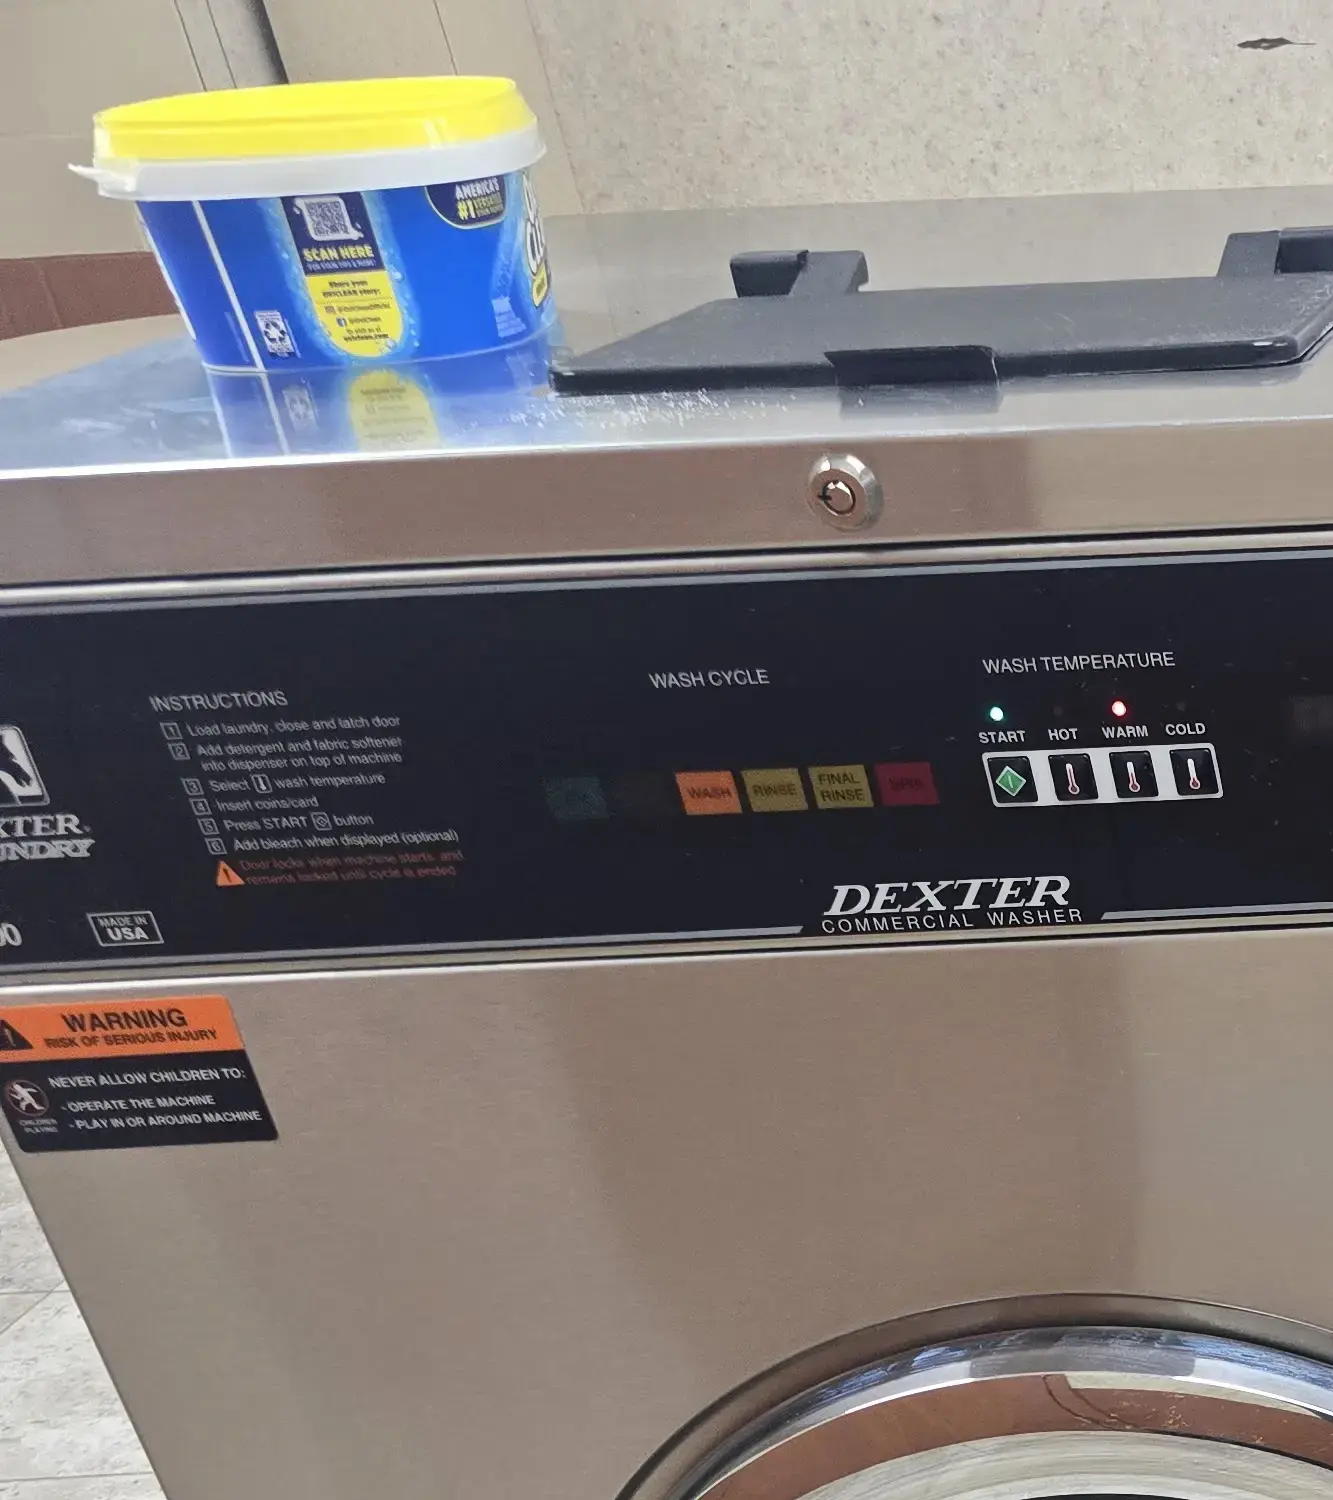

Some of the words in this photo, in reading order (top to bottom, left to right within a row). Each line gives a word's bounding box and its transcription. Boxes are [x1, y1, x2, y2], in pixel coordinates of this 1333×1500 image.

[457, 199, 476, 221] #1
[303, 247, 337, 262] SCAN
[340, 245, 375, 259] HERE
[982, 657, 1038, 675] WASH
[1043, 652, 1176, 672] TEMPERATURE
[648, 672, 706, 690] WASH
[706, 669, 771, 687] CYCLE
[149, 690, 288, 712] INSTRUCTIONS
[978, 730, 1027, 744] START
[1047, 728, 1078, 741] HOT
[1101, 725, 1149, 740] WARM
[1165, 722, 1206, 736] COLD
[817, 773, 861, 785] FINAL
[686, 786, 733, 800] WASH
[752, 782, 797, 797] RINSE
[820, 788, 867, 802] RINSE
[822, 876, 1071, 916] DEXTER
[821, 912, 974, 935] COMMERCIAL
[986, 909, 1084, 926] WASHER
[106, 927, 149, 942] USA
[61, 1008, 188, 1033] WARNING
[43, 1036, 79, 1049] RISK
[79, 1035, 101, 1047] OF
[101, 1031, 167, 1046] SERIOUS
[165, 1028, 218, 1042] INJURY
